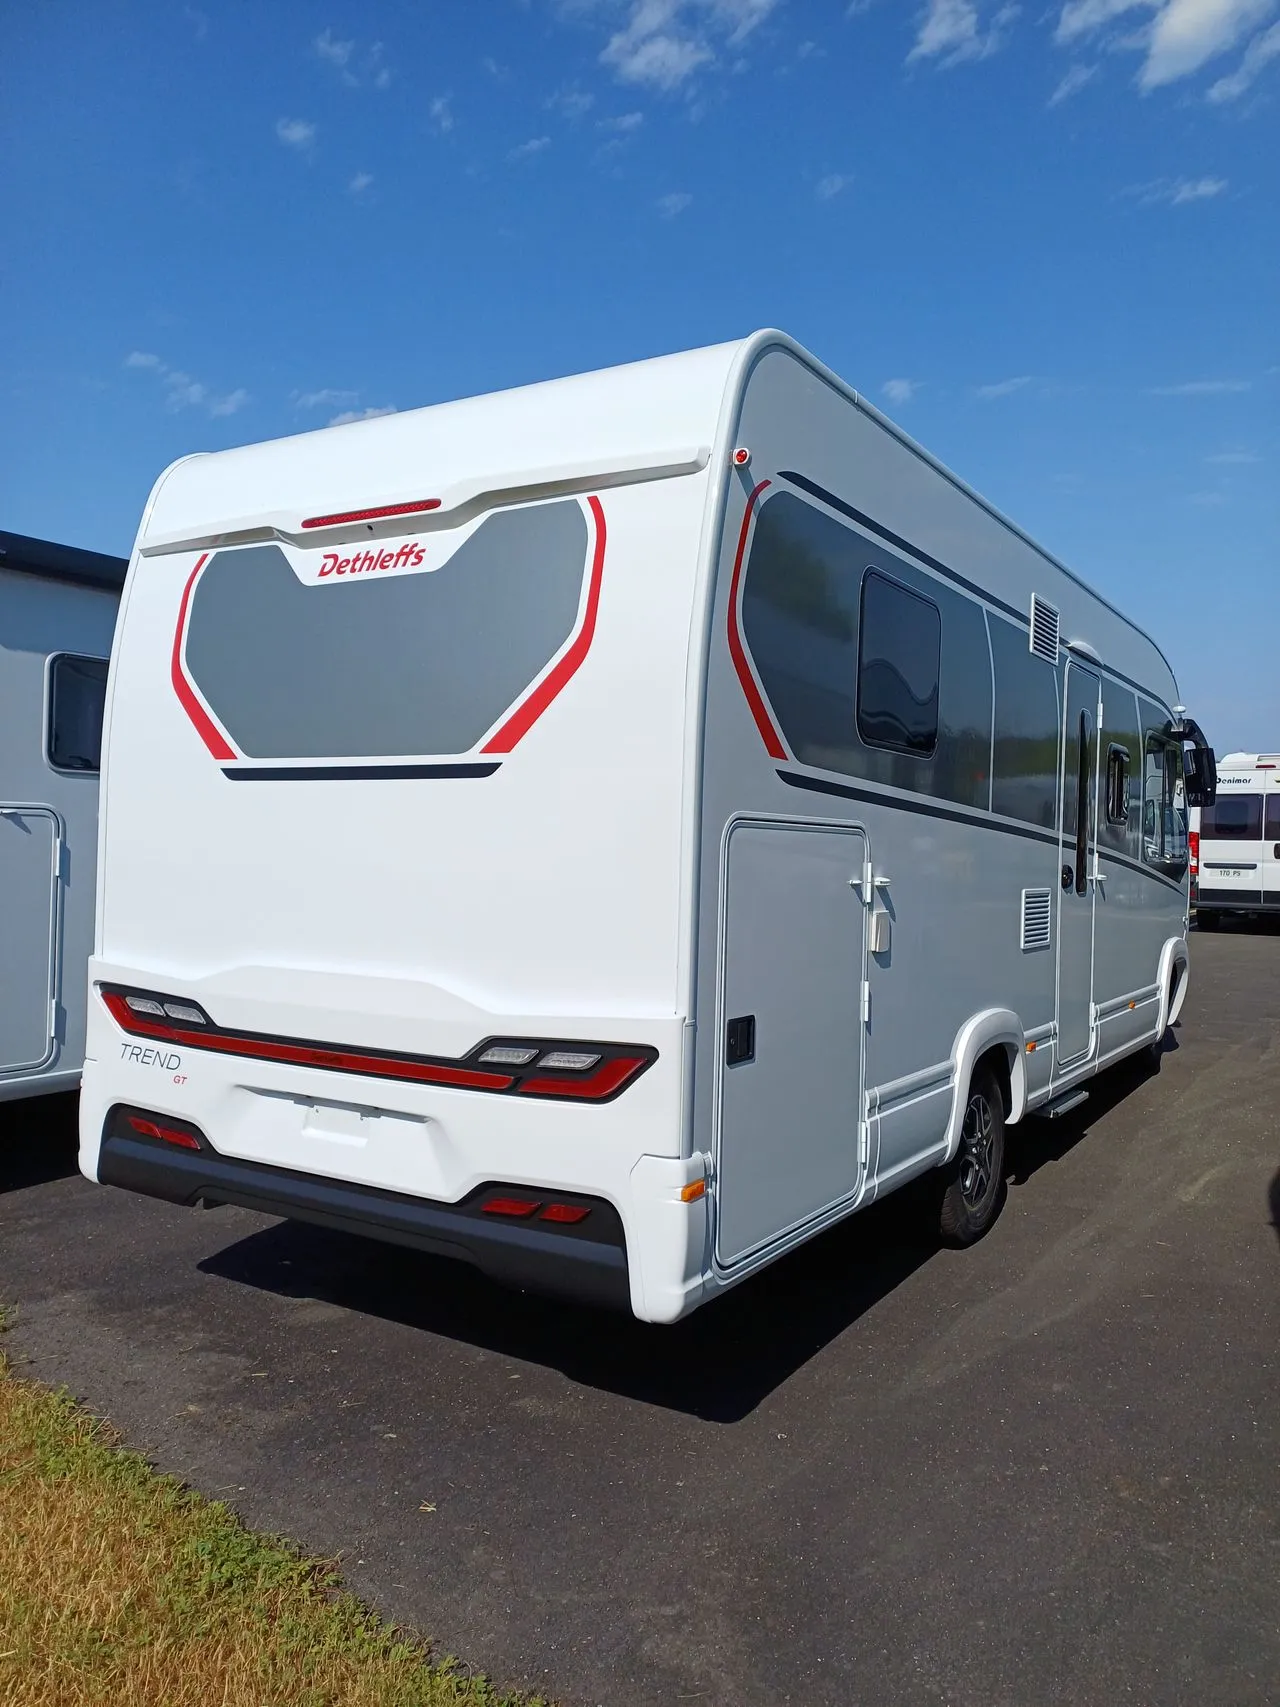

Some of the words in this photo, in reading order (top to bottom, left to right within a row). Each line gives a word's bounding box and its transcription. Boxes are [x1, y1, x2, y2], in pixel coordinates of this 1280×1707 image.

[317, 542, 427, 578] Dethleffs
[1219, 870, 1231, 878] 170
[120, 1043, 182, 1071] TREND
[173, 1075, 188, 1085] GT
